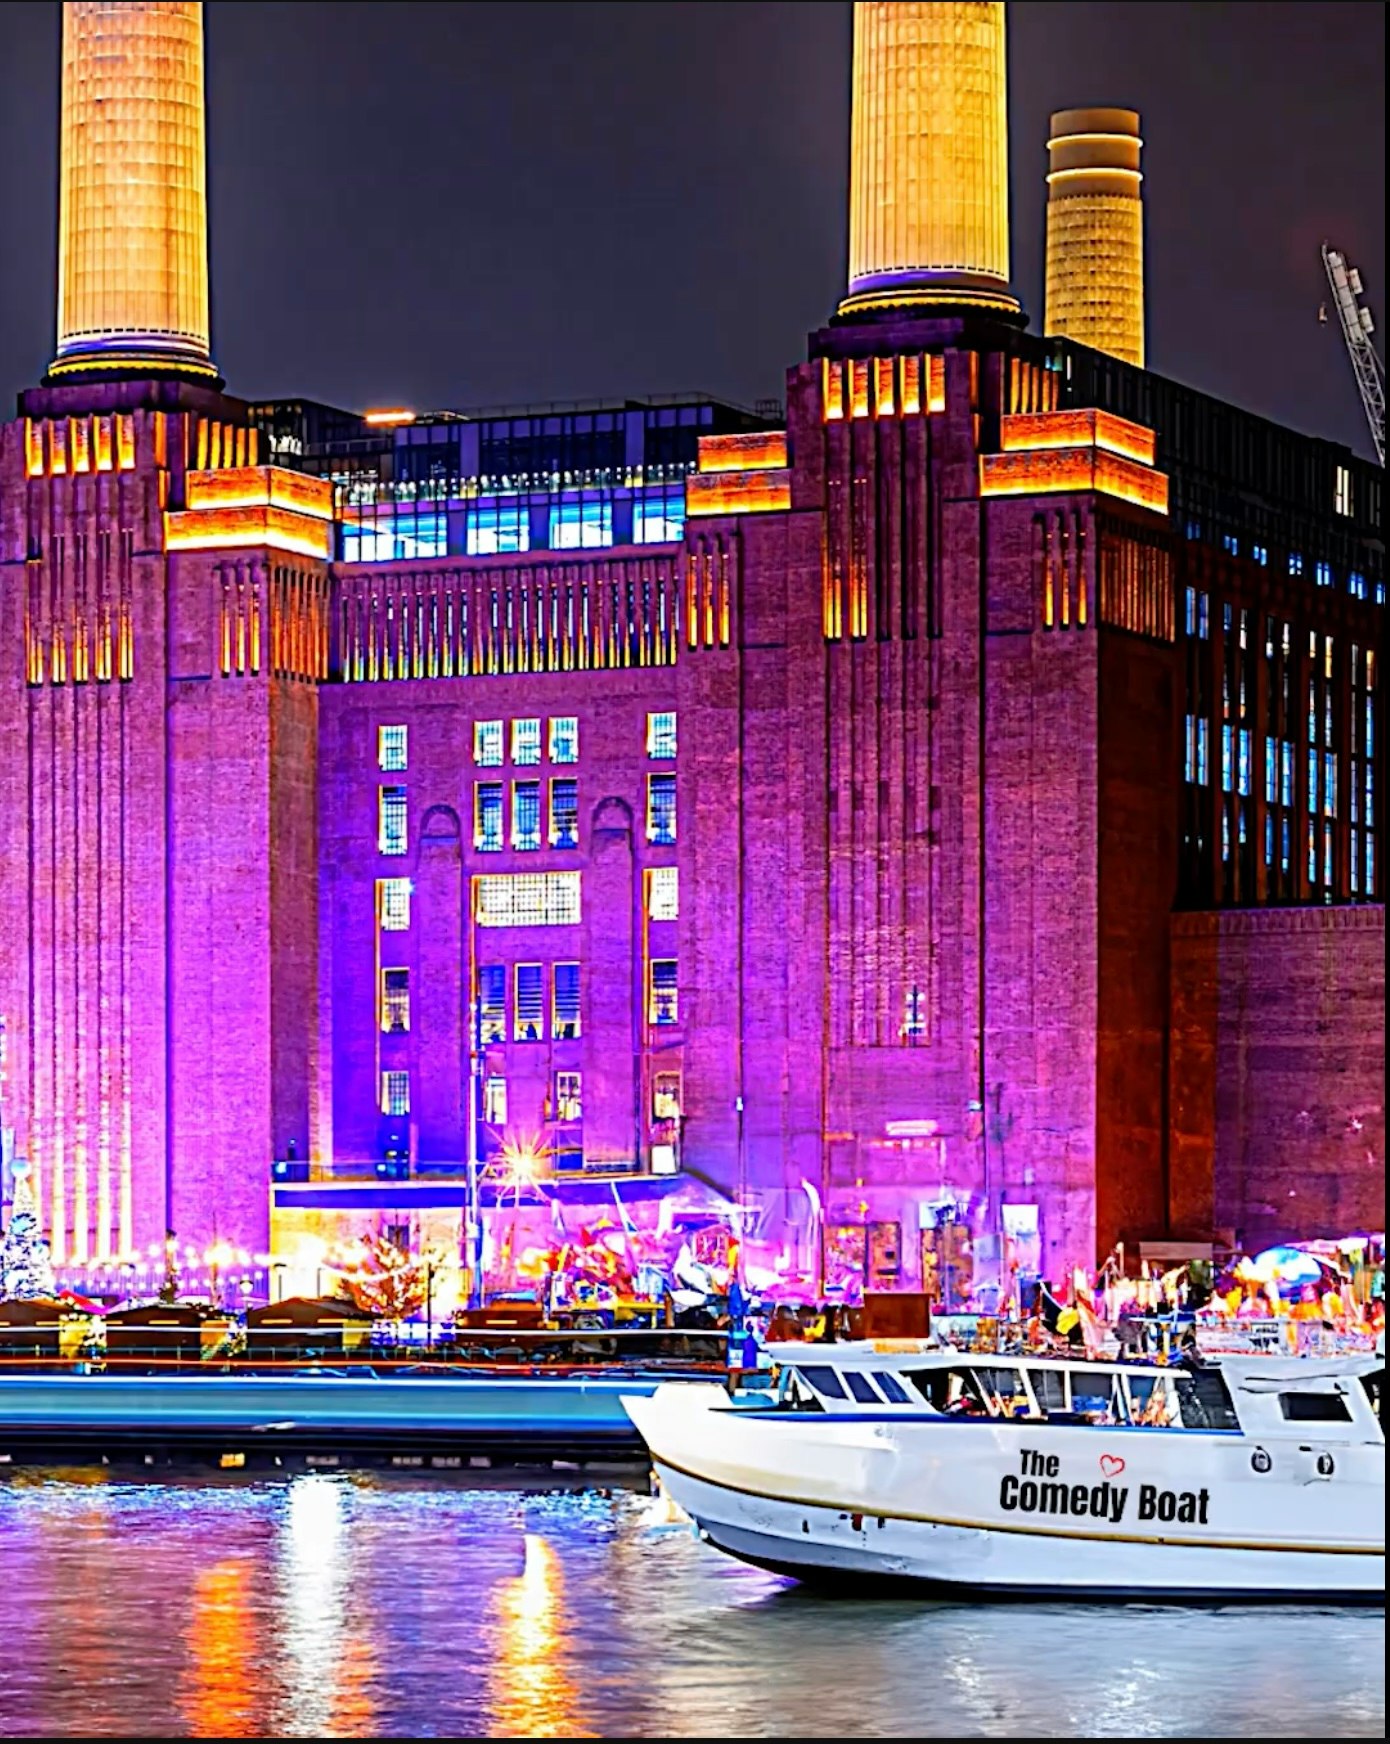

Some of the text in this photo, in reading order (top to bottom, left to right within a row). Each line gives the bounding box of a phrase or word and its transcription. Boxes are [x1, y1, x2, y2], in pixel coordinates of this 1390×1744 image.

[1020, 1449, 1060, 1478] The
[1000, 1475, 1210, 1524] Comedy Boat
